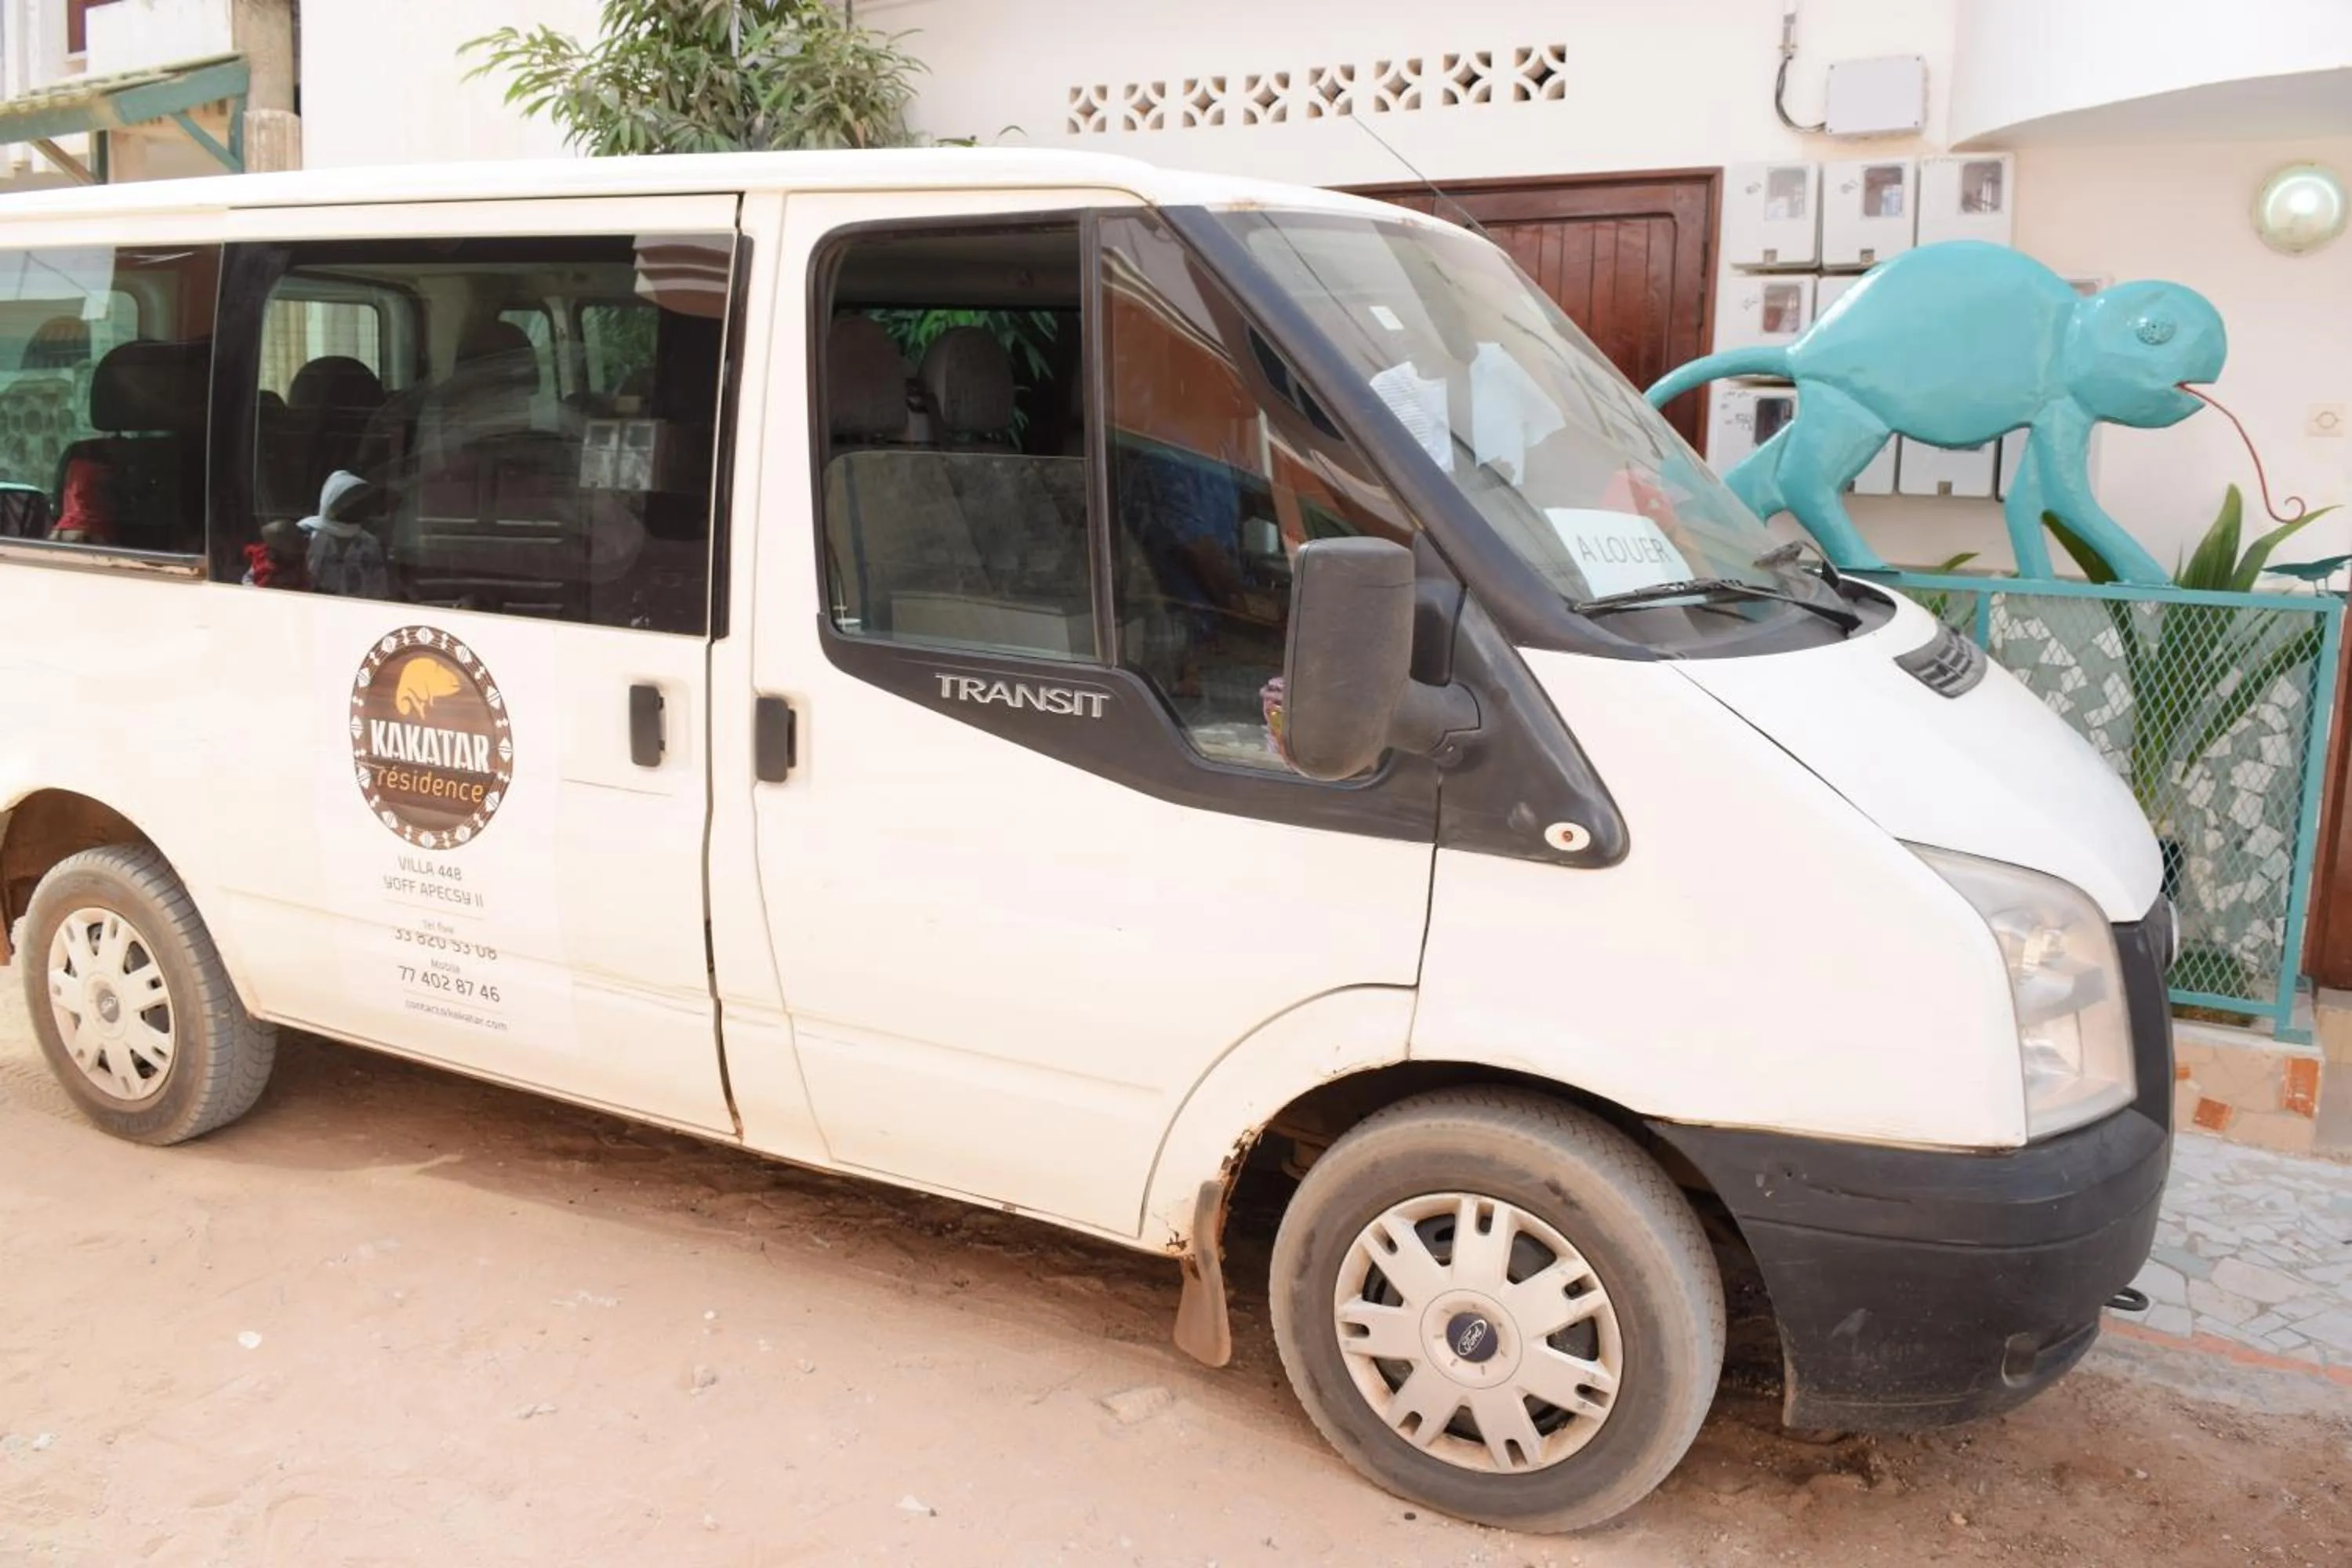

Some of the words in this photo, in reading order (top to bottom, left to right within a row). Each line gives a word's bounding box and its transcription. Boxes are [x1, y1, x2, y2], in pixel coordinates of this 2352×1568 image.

[1595, 536, 1674, 563] LOUER
[935, 673, 1110, 717] TRANSIT
[370, 719, 491, 773] KAKATAR
[376, 764, 485, 803] résidence
[397, 855, 434, 876] VILLA
[397, 964, 416, 982] 77
[421, 971, 452, 991] 402
[456, 978, 474, 996] 87
[480, 985, 501, 1003] 46
